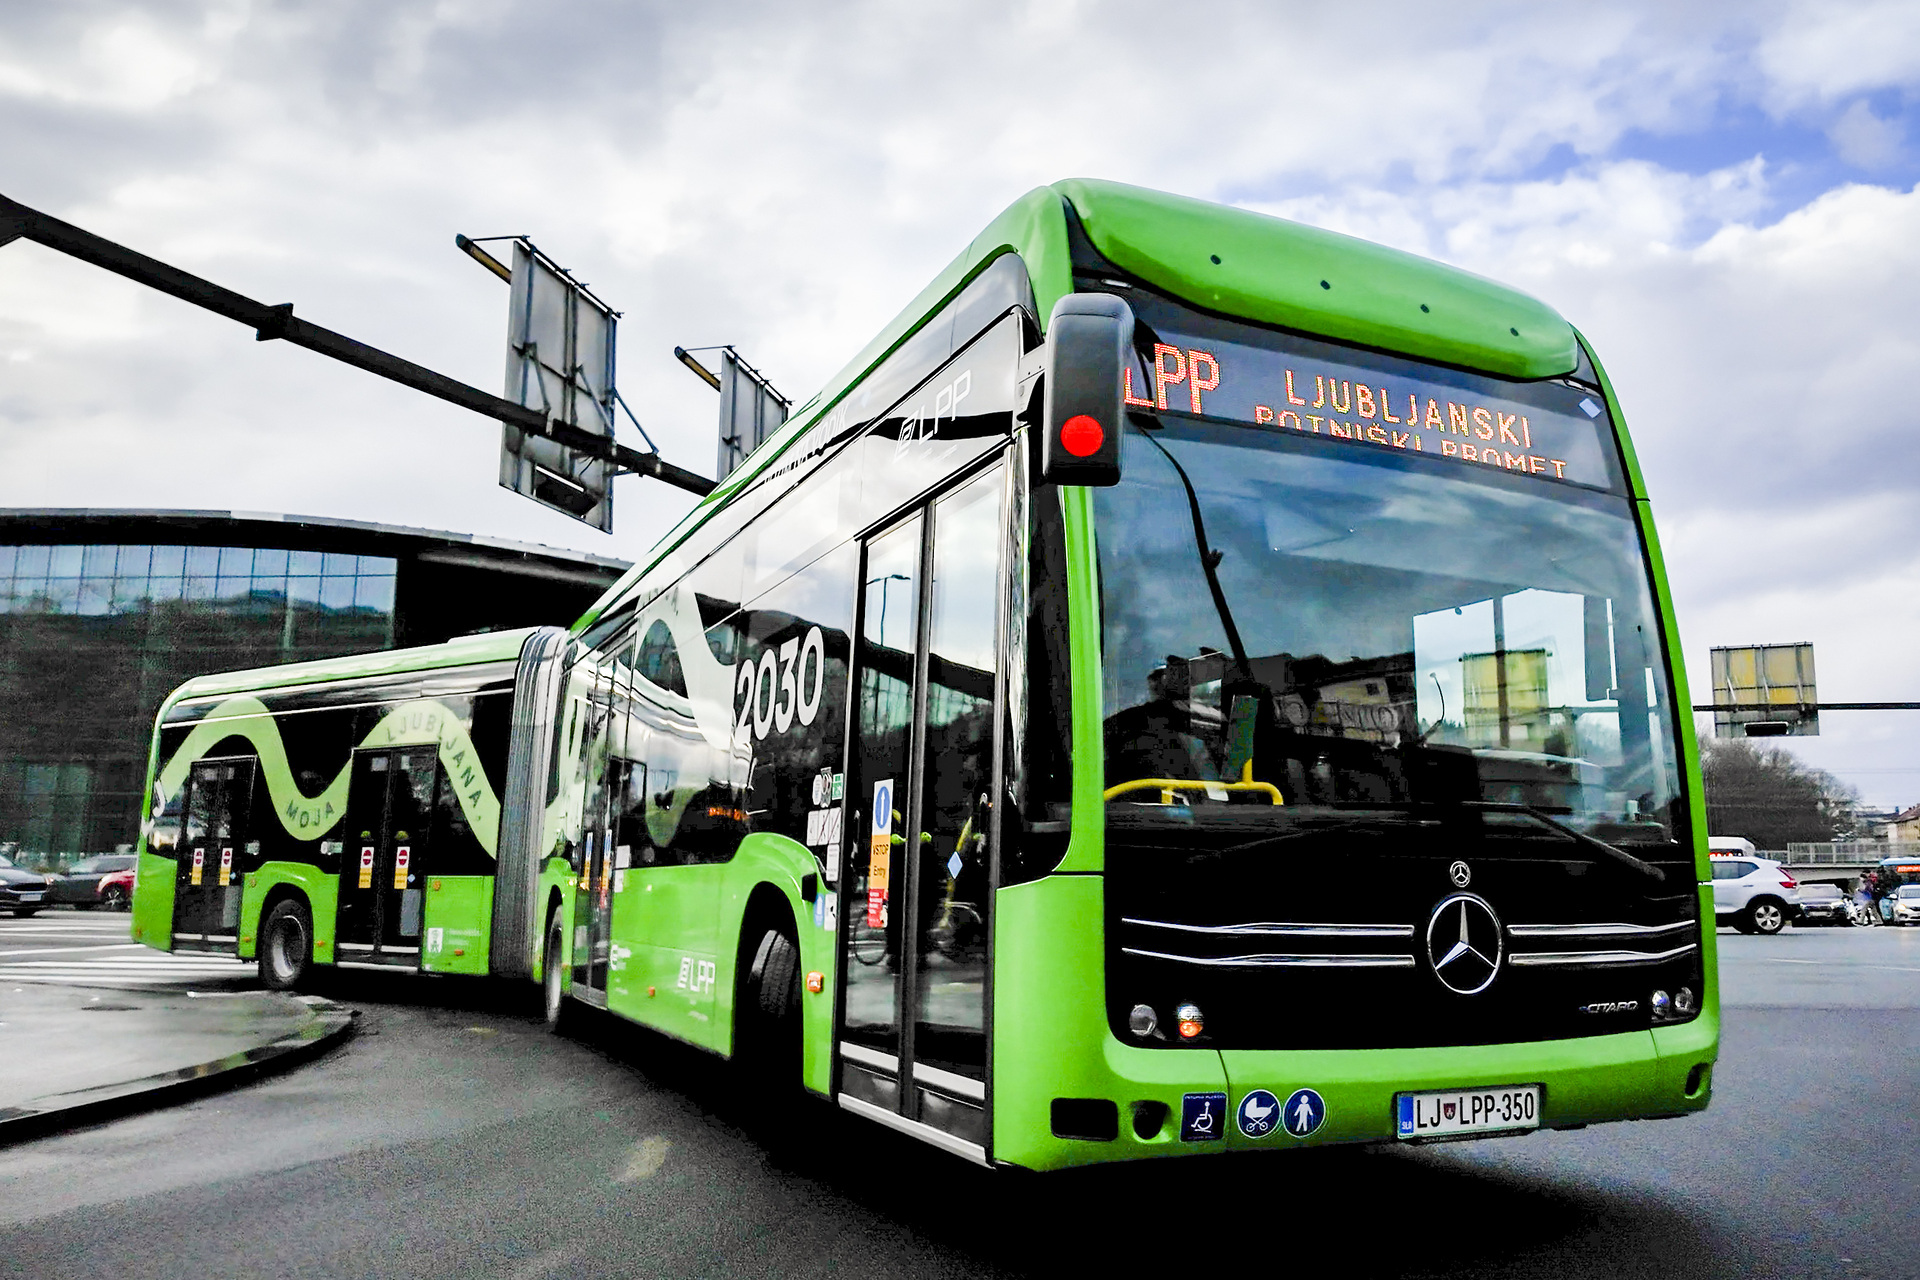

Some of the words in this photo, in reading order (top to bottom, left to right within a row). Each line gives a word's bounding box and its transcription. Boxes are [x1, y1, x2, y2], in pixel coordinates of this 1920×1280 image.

[919, 369, 971, 445] LPP
[1124, 343, 1220, 414] LPP
[1285, 369, 1532, 448] LJUBLJANSKI
[734, 625, 824, 746] 2030
[286, 799, 335, 828] MOJA
[690, 957, 716, 995] LPP
[1416, 1098, 1441, 1128] LJ
[1459, 1092, 1534, 1125] LPP-350
